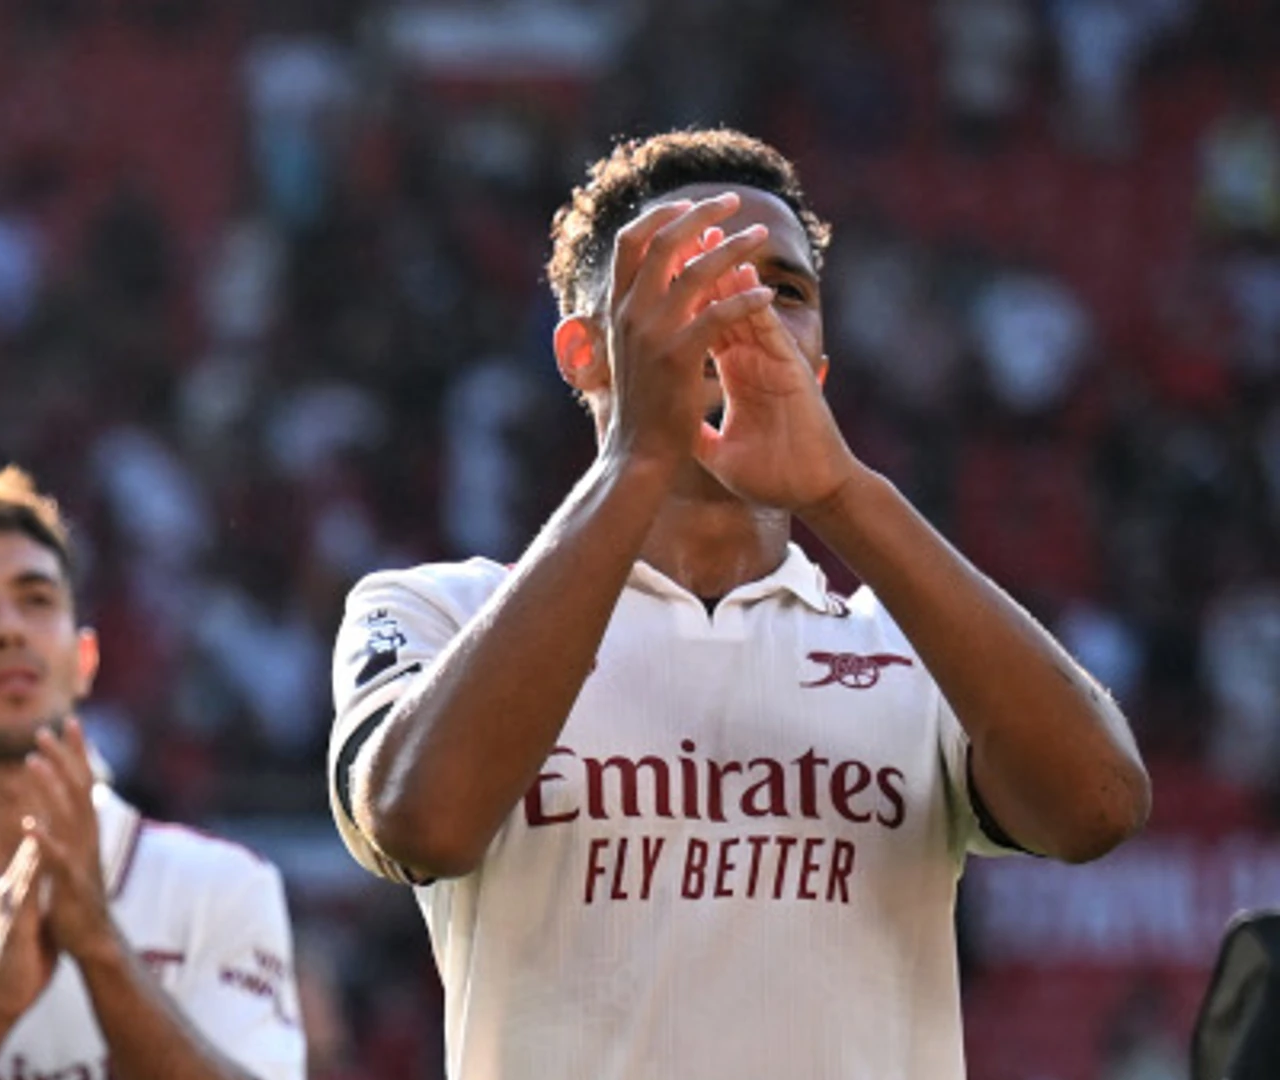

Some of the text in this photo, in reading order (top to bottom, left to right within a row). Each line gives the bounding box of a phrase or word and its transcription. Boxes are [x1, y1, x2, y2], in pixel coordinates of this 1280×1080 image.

[524, 739, 907, 829] Emirates
[584, 836, 856, 904] FLY BETTER
